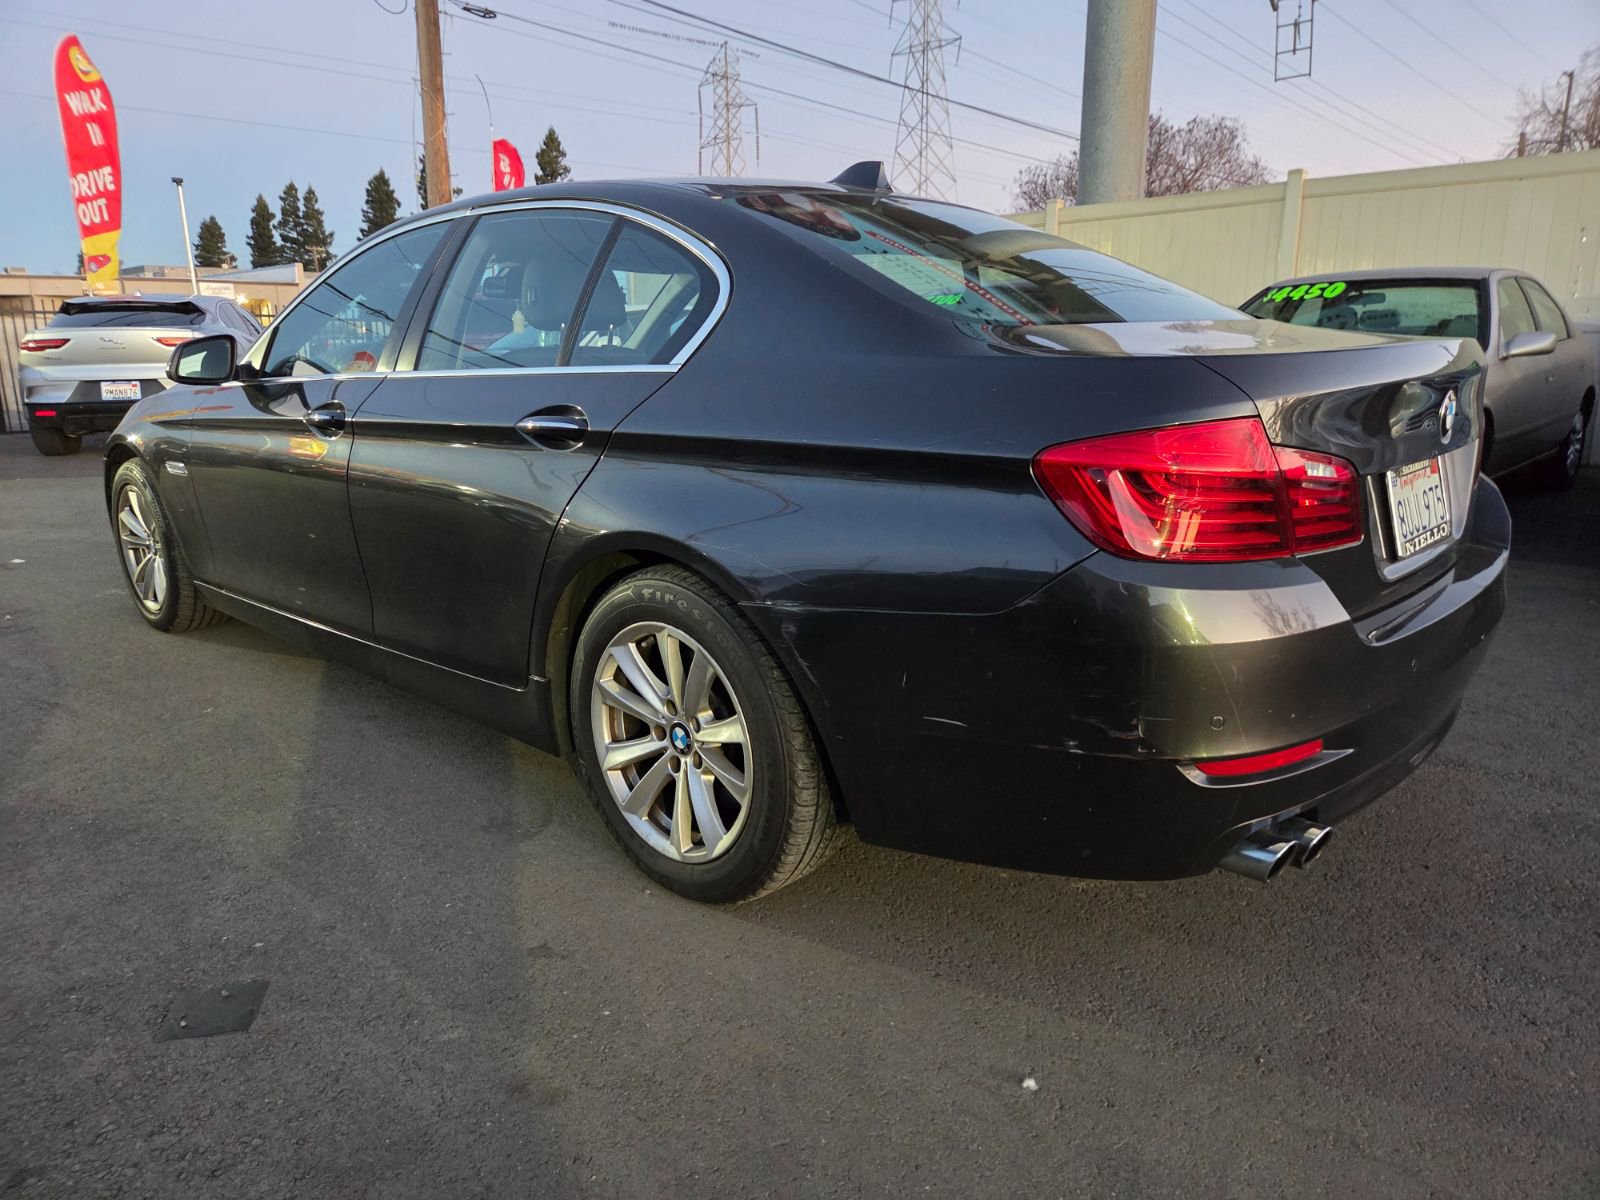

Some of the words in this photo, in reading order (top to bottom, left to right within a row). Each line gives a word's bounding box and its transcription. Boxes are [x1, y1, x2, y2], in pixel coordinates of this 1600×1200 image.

[79, 198, 109, 226] OUT
[1397, 485, 1445, 539] 8UJL975
[1405, 523, 1448, 556] NIELLO
